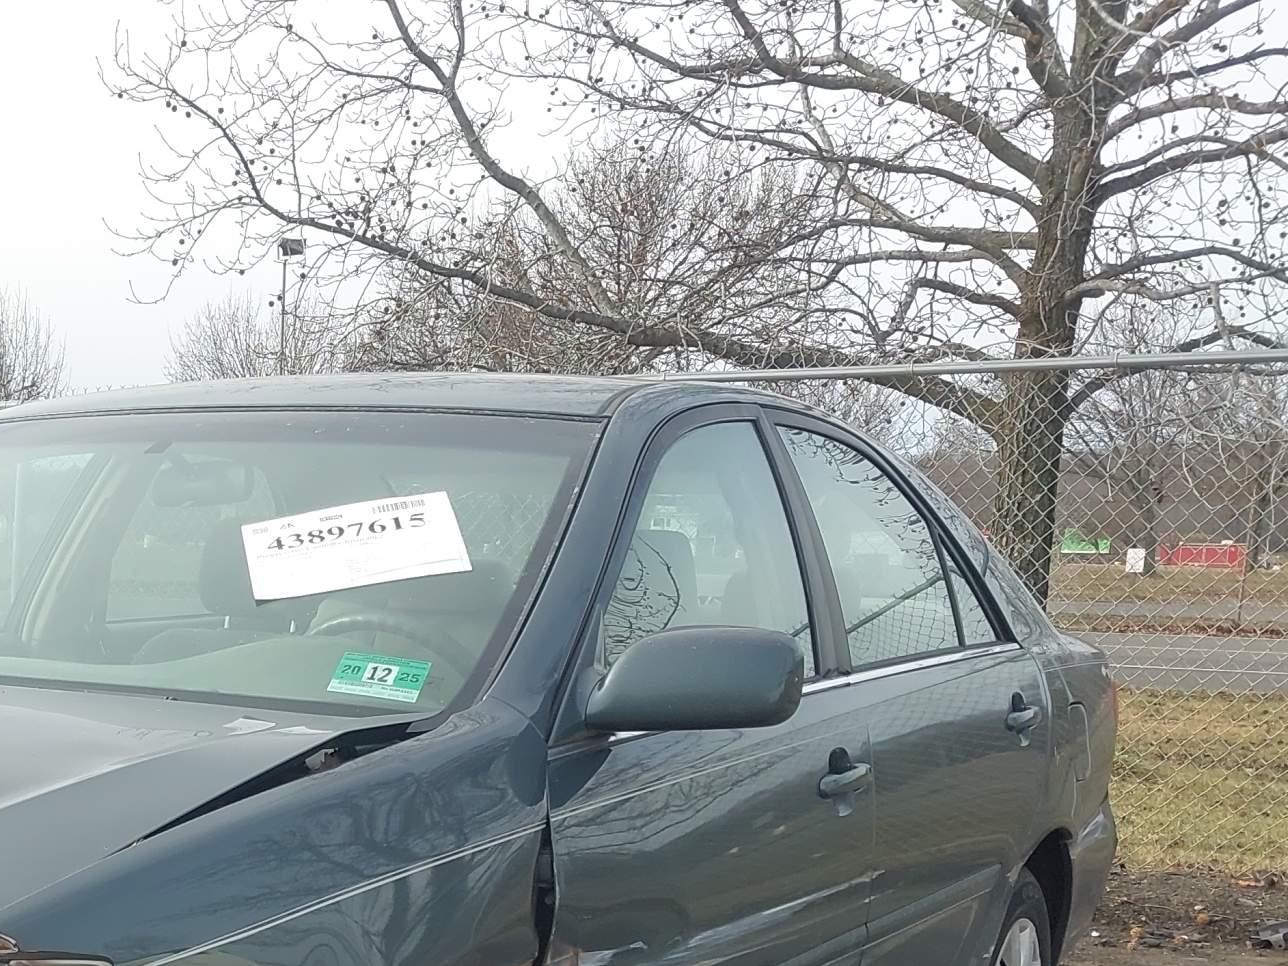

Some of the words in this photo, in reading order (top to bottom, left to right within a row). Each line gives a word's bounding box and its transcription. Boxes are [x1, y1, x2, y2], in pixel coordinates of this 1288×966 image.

[267, 512, 426, 551] 43897615
[341, 664, 362, 675] 20
[367, 665, 393, 683] 12
[397, 672, 422, 683] 25
